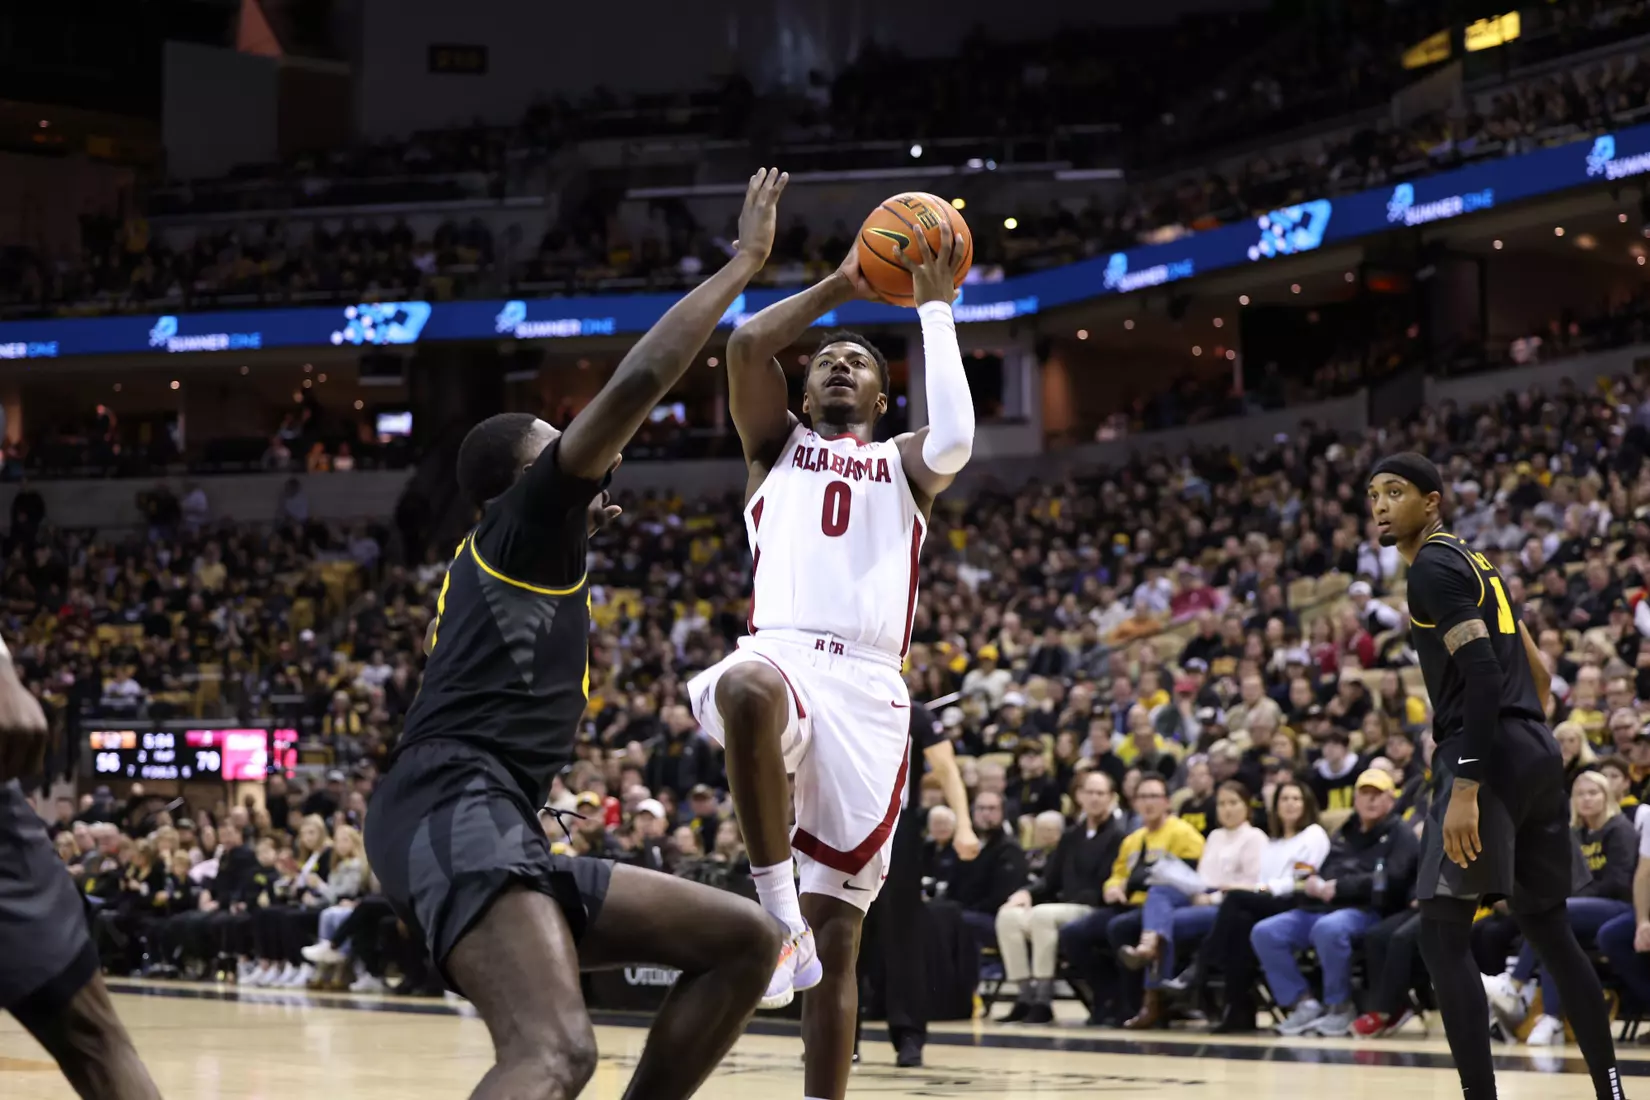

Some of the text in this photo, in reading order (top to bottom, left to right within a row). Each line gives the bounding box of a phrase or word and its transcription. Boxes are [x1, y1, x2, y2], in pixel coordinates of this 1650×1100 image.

[792, 444, 892, 483] ALABAMA
[821, 481, 852, 537] 0
[195, 750, 221, 772] 70
